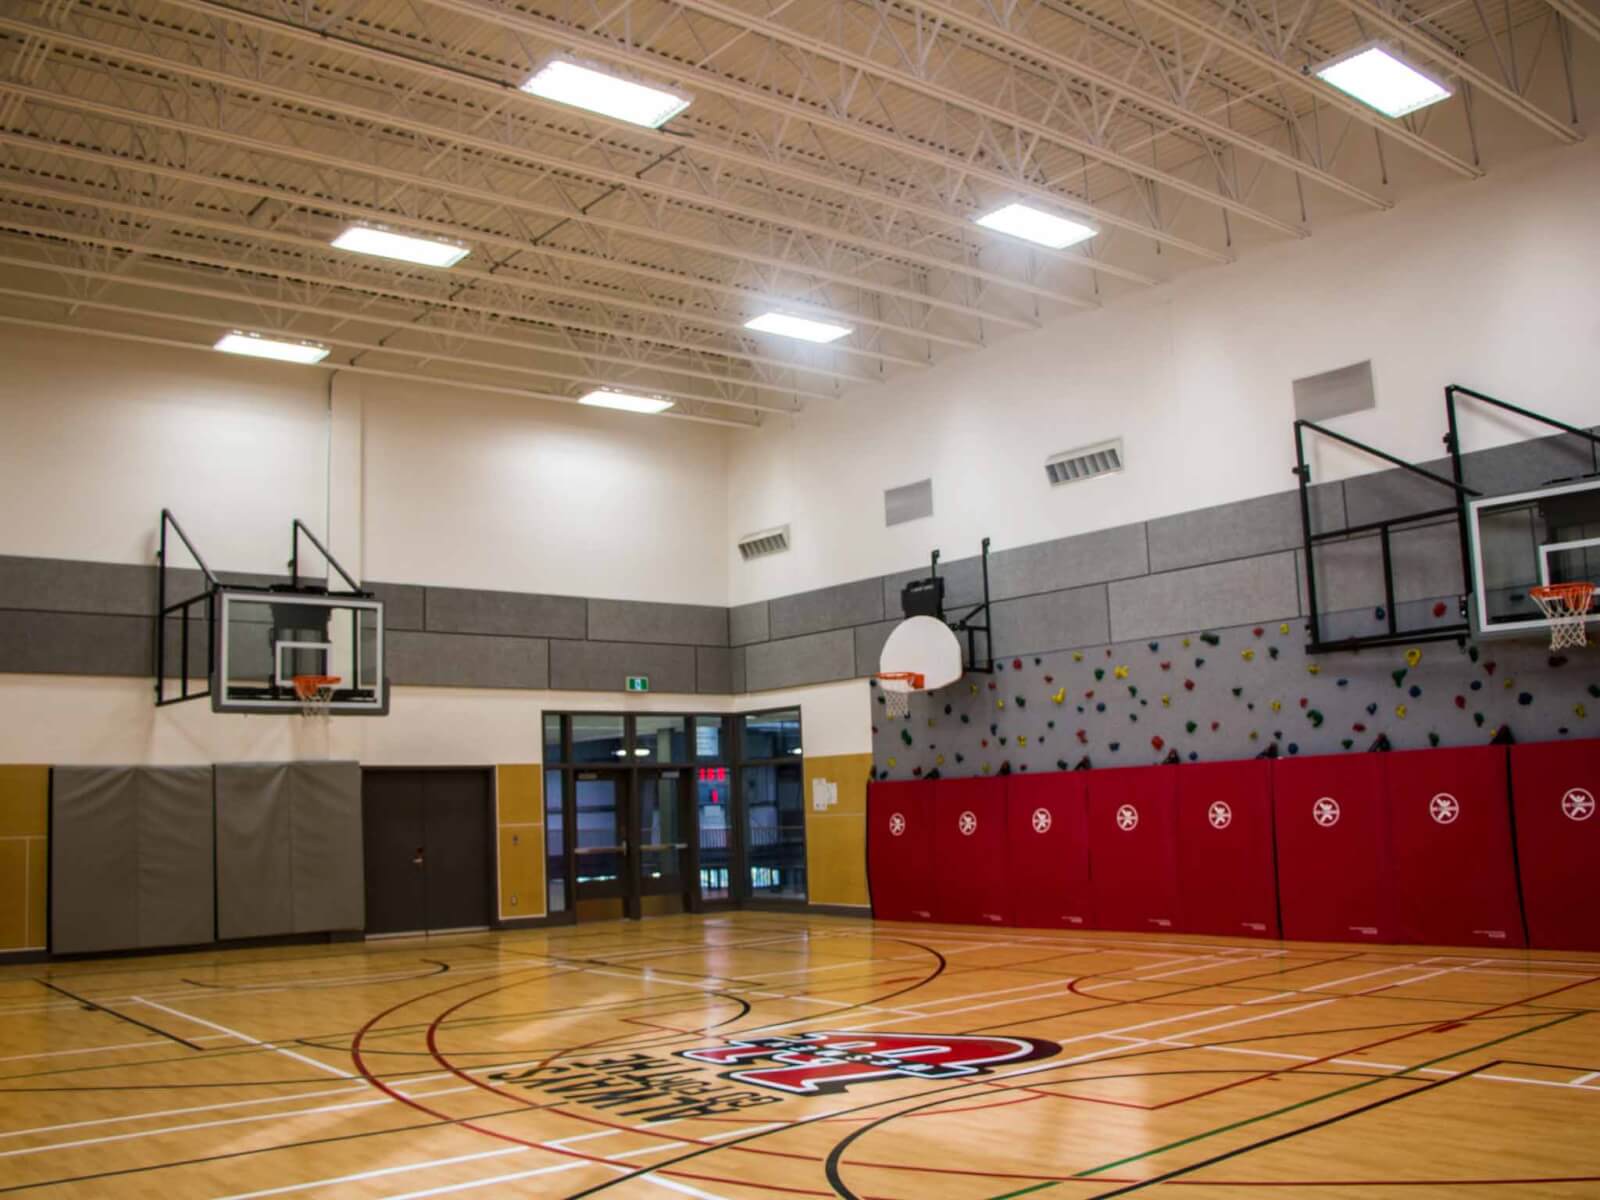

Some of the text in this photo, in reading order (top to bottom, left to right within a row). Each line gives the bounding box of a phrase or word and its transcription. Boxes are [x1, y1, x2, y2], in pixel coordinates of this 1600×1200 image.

[488, 1066, 739, 1122] ALWAYS
[570, 1054, 784, 1107] GO FOR THE
